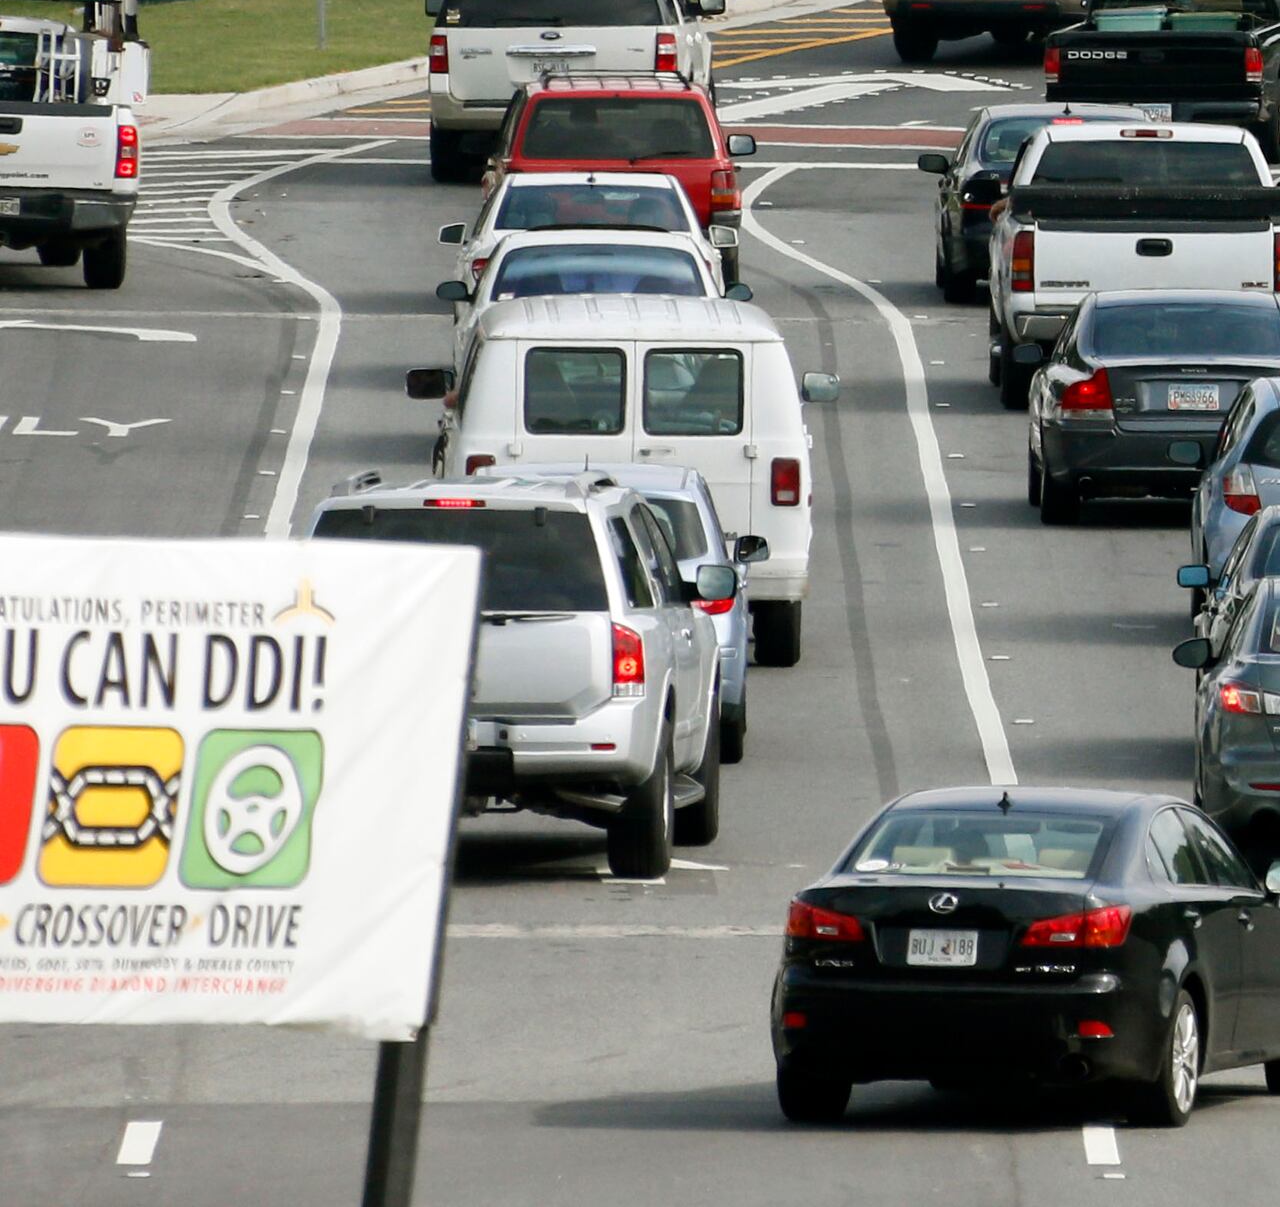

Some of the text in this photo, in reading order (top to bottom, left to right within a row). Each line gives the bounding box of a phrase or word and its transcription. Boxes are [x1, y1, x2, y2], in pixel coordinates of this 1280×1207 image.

[1067, 51, 1128, 60] DODGE
[140, 600, 265, 626] PERIMETER
[60, 629, 179, 710] CAN
[202, 633, 328, 713] DDI!
[15, 902, 303, 949] CROSSOVER DRIVE
[246, 959, 295, 974] COUNTY
